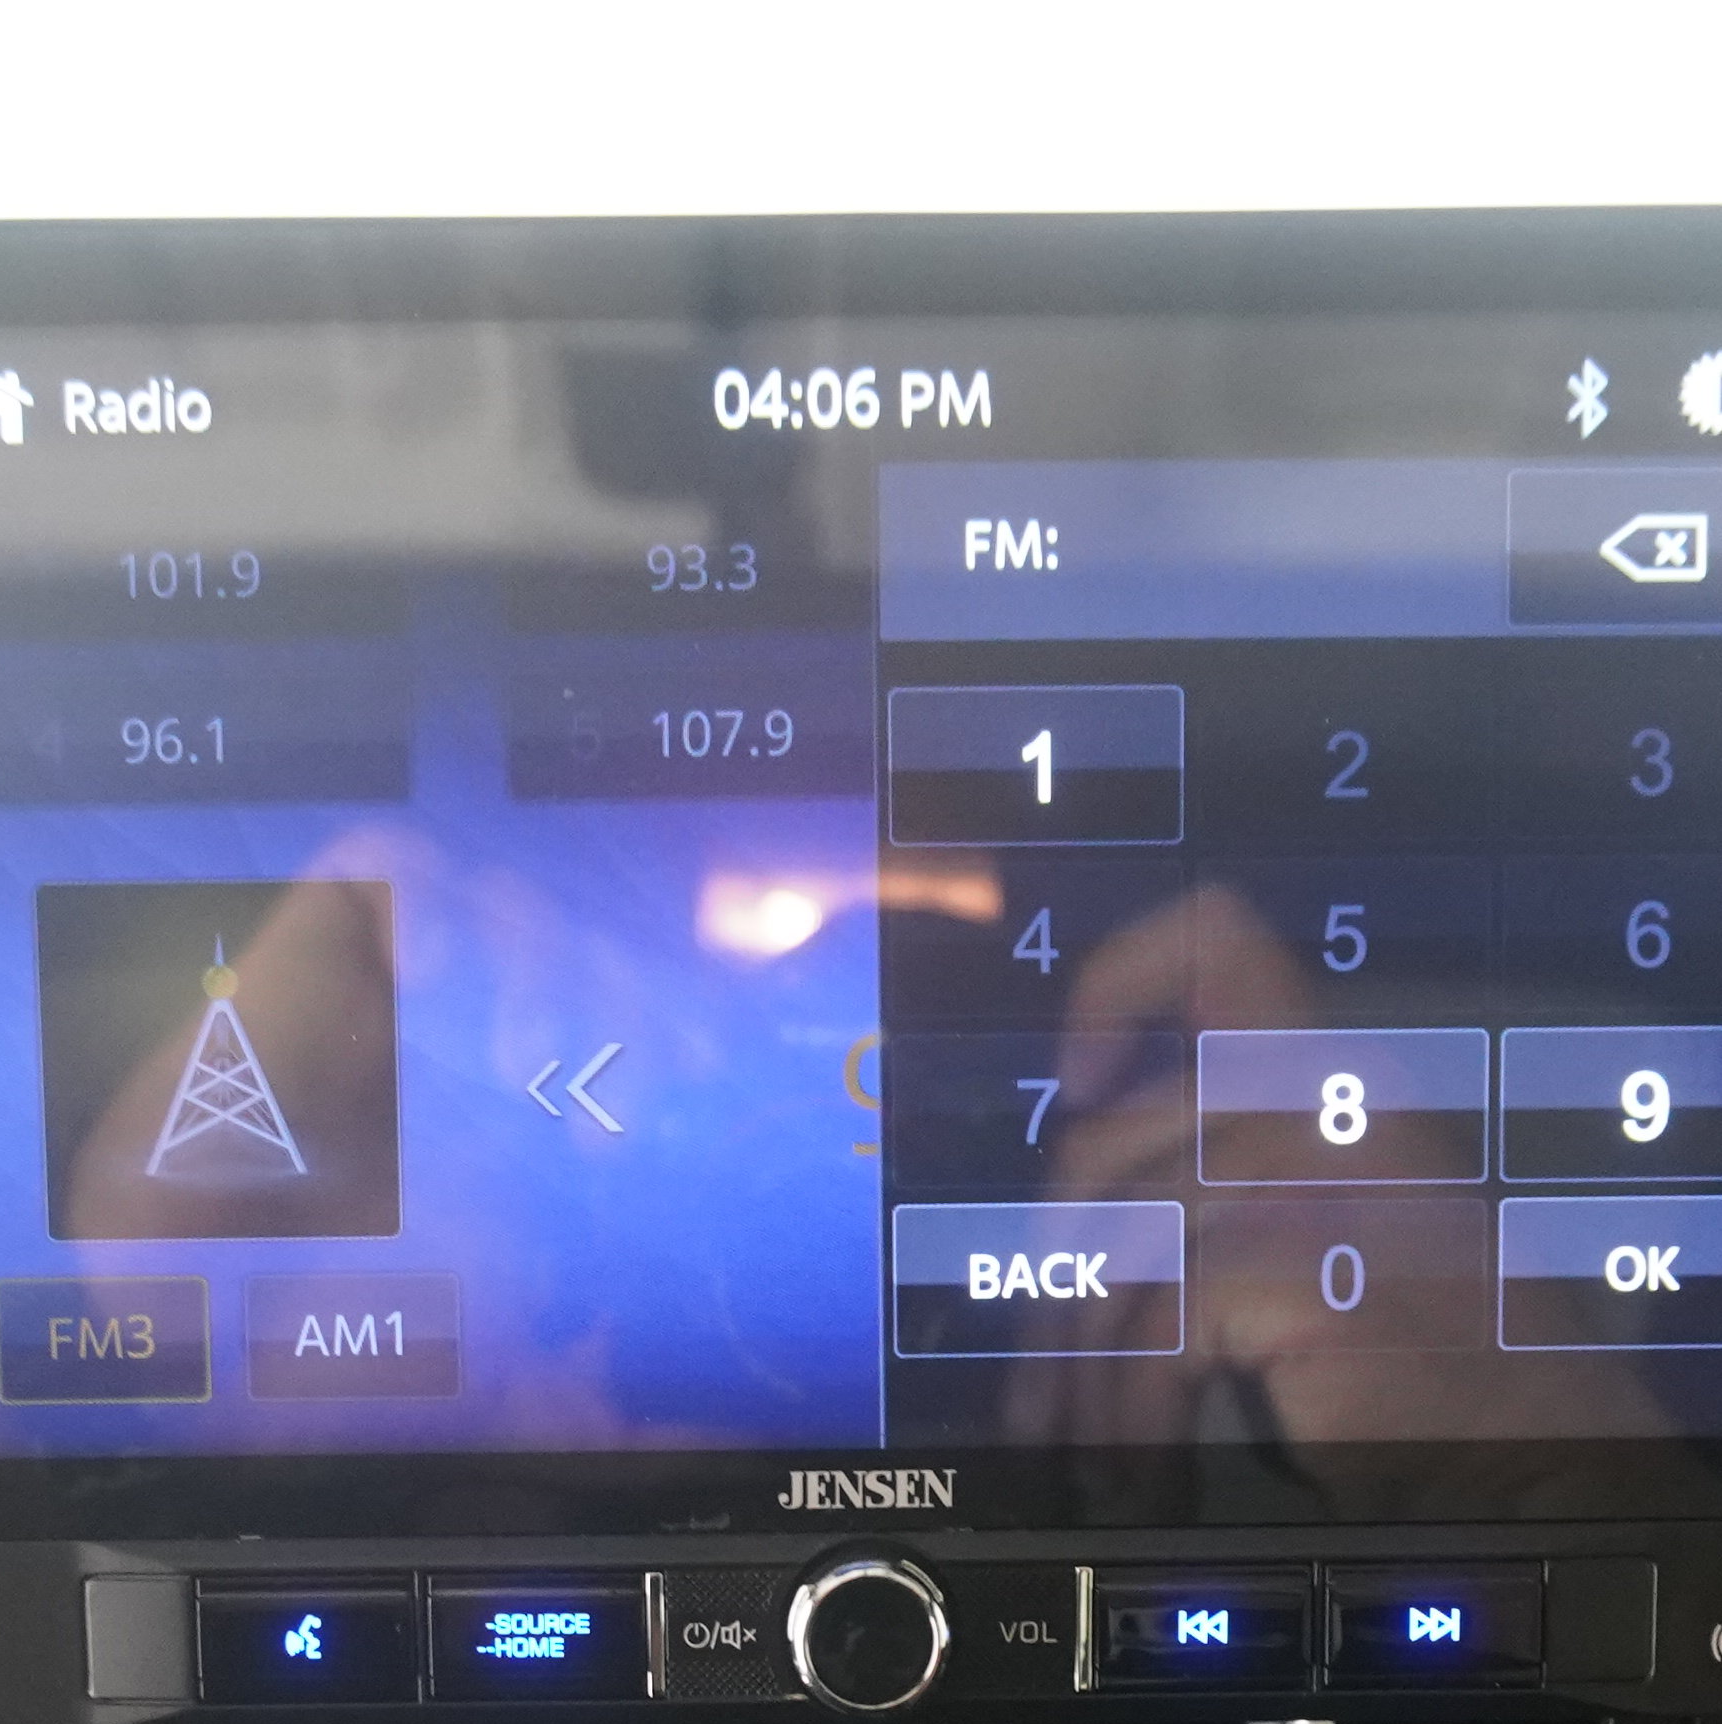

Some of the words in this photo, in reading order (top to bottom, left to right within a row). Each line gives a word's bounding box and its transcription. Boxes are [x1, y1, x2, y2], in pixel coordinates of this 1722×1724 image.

[62, 376, 213, 434] Radio
[713, 367, 882, 430] 04:06
[900, 369, 993, 429] PM
[645, 543, 759, 593] 93.3
[964, 519, 1060, 571] FM:
[119, 551, 262, 600] 101.9
[119, 717, 227, 765] 96.1
[653, 709, 795, 758] 107.9
[1020, 729, 1054, 805] 1
[1323, 729, 1370, 799] 2
[1629, 728, 1674, 798] 3
[1012, 907, 1061, 974] 4
[1321, 904, 1369, 972] 5
[1625, 900, 1672, 969] 6
[1016, 1079, 1061, 1146] 7
[1318, 1072, 1369, 1146] 8
[1620, 1069, 1672, 1143] 9
[968, 1252, 1109, 1300] BACK
[1319, 1243, 1366, 1312] 0
[1604, 1245, 1682, 1293] OK
[49, 1315, 157, 1360] FM3
[294, 1311, 404, 1358] AM1
[777, 1468, 958, 1510] JENSEN
[999, 1621, 1059, 1644] VOL
